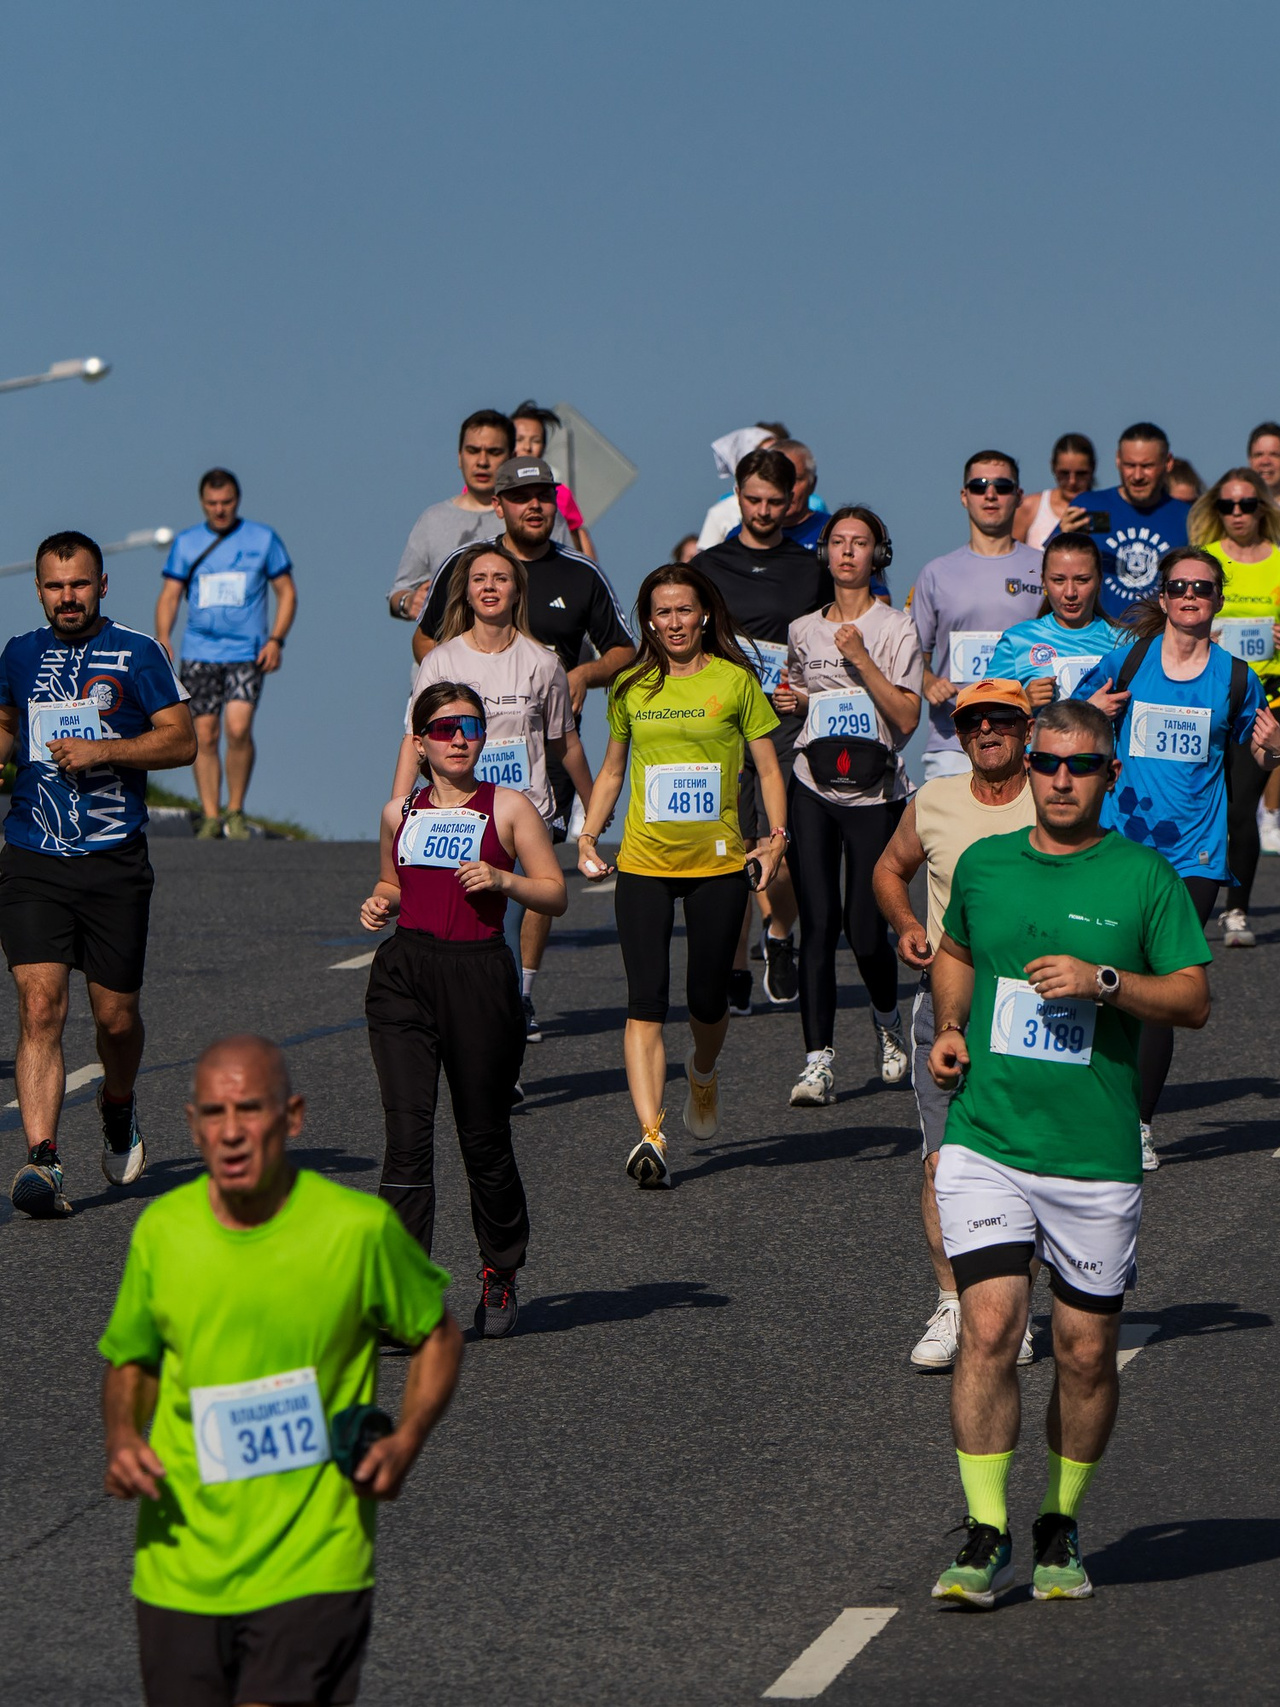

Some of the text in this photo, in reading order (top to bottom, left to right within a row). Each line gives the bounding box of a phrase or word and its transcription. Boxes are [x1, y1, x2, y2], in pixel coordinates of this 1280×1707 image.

[1105, 527, 1170, 553] BAUMAN
[1239, 638, 1266, 657] 169
[635, 708, 705, 720] AstraZeneca
[838, 702, 854, 712] ЯНА
[59, 715, 80, 726] ИВАН
[827, 713, 871, 737] 2299
[1163, 719, 1197, 731] ТАТЬЯНА
[1156, 731, 1202, 755] 3133
[481, 751, 515, 763] НАТАЛЬЯ
[480, 763, 522, 784] 1046
[673, 778, 707, 789] ЕВГЕНИЯ
[668, 791, 714, 814] 4818
[430, 823, 476, 834] АНАСТАСИЯ
[423, 836, 473, 861] 5062
[1023, 1019, 1084, 1054] 3189
[972, 1216, 1002, 1229] SPORT
[238, 1416, 318, 1465] 3412
